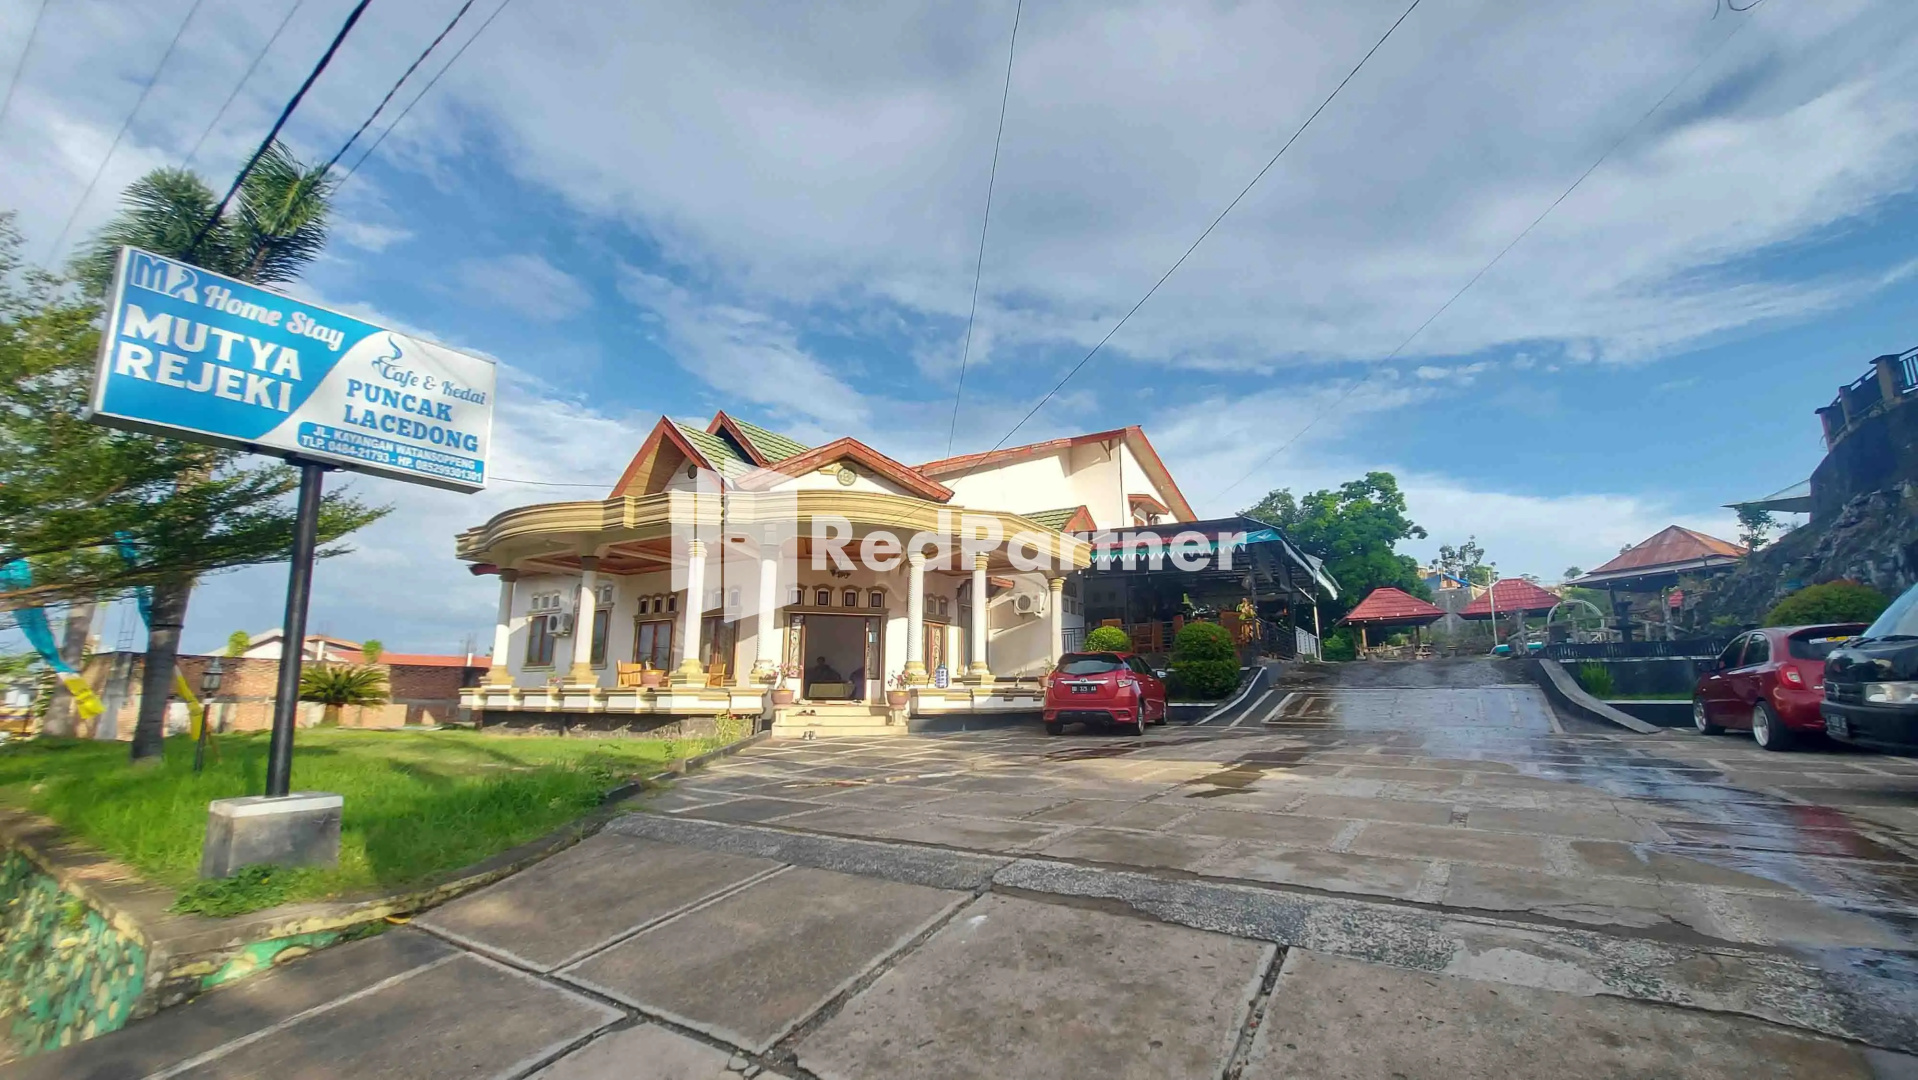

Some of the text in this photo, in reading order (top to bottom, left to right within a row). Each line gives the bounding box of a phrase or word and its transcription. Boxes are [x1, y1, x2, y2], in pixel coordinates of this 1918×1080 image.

[204, 285, 345, 351] Home Stay
[121, 303, 302, 381] MUTYA
[115, 341, 294, 412] REJEKI
[382, 364, 486, 405] Cafe & Kedai
[346, 378, 453, 422] PUNCAK
[301, 435, 325, 449] TLP.
[334, 430, 395, 452] KAYANGAN
[395, 442, 476, 470] WATANSOPPENG
[343, 404, 479, 452] LACEDONG
